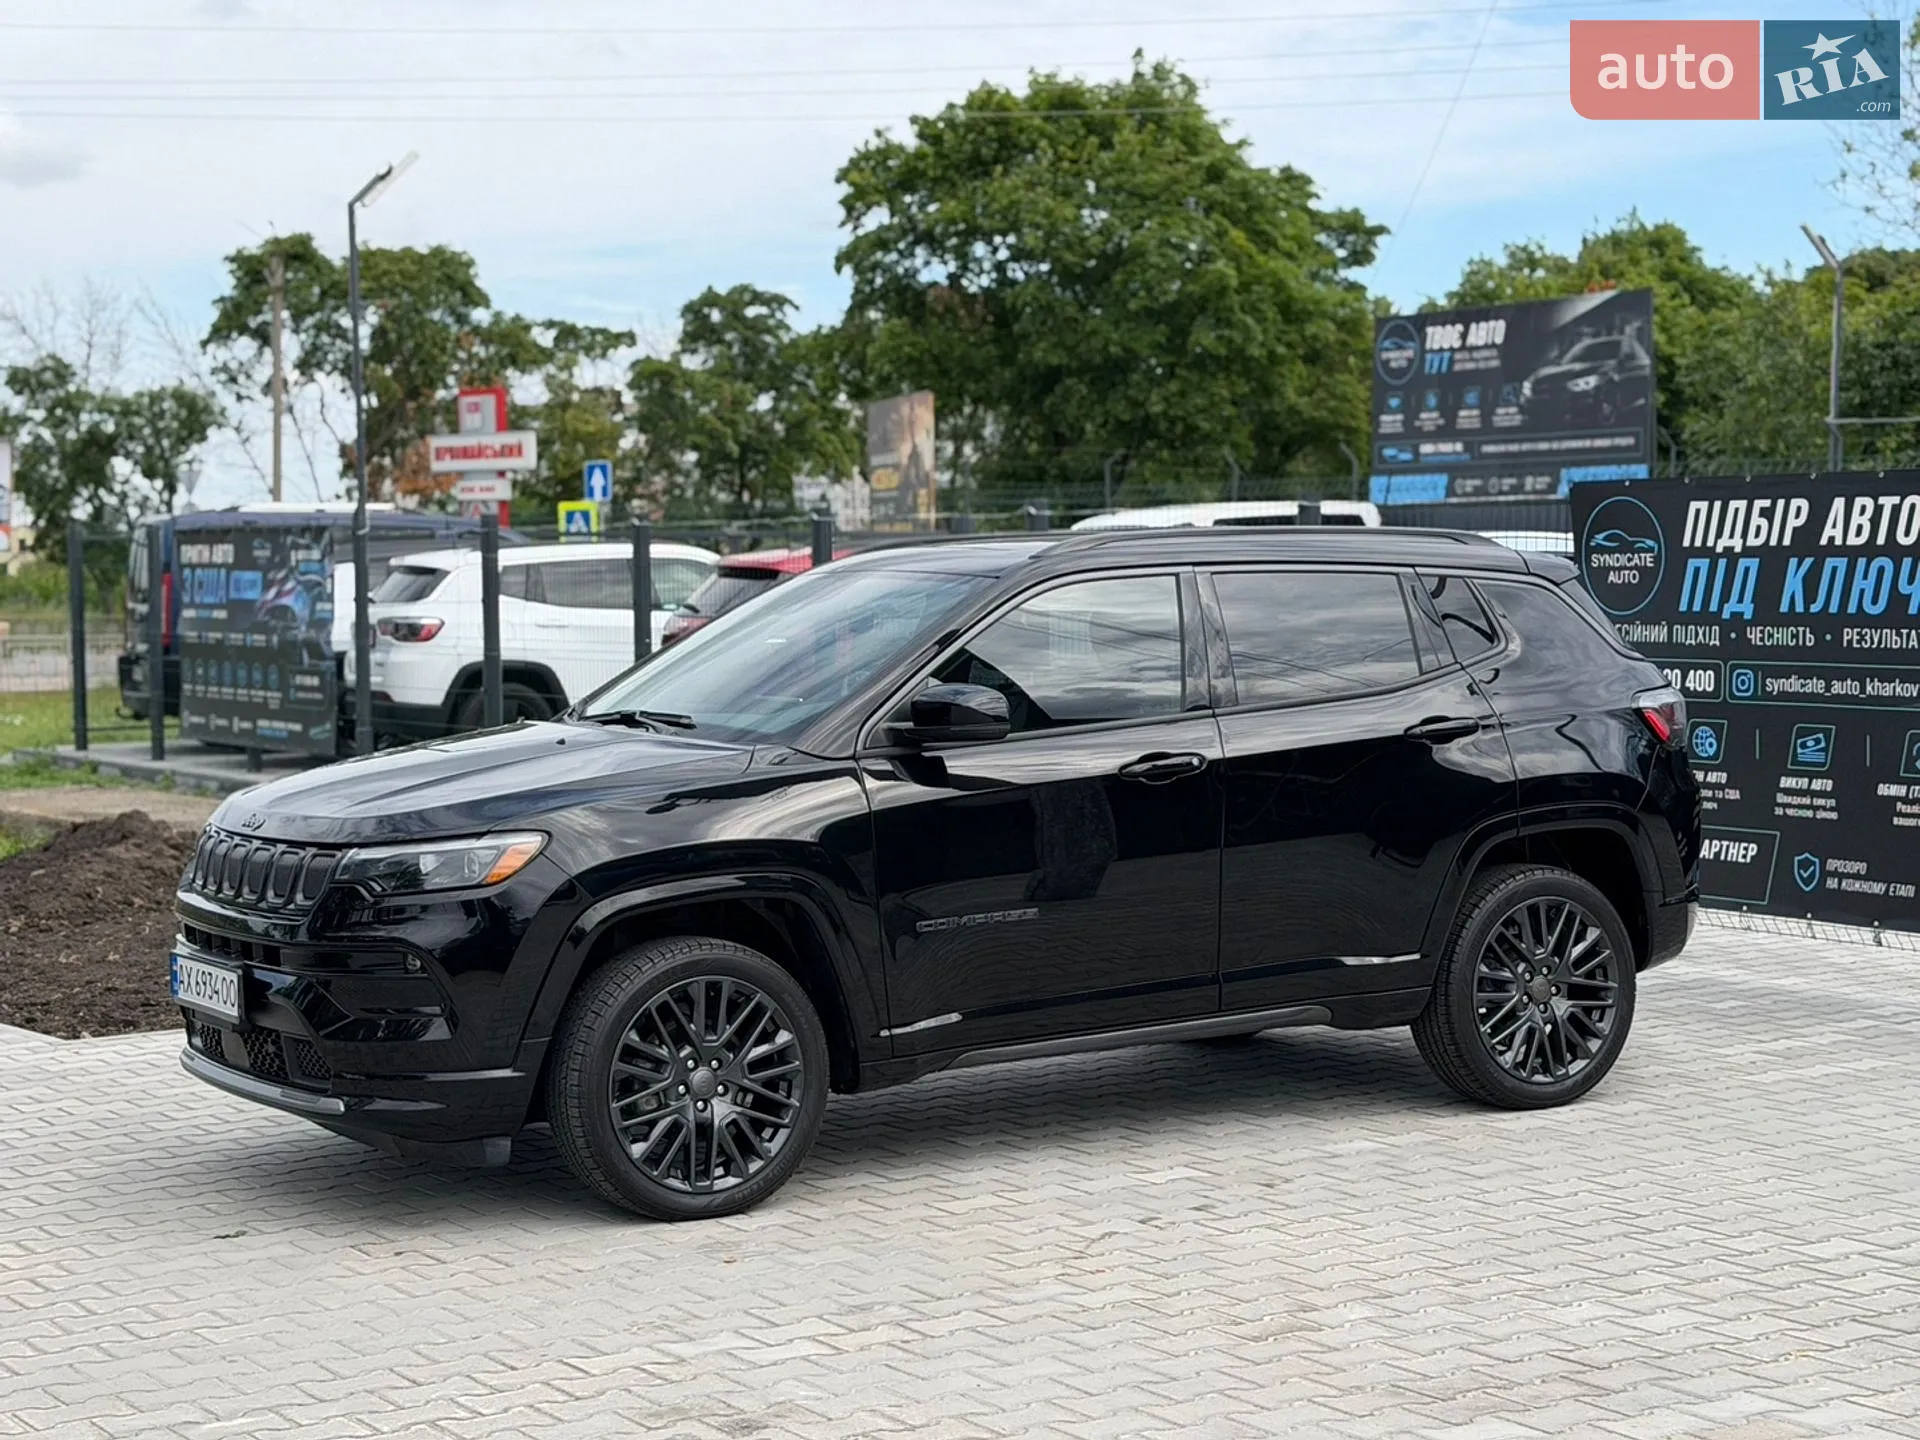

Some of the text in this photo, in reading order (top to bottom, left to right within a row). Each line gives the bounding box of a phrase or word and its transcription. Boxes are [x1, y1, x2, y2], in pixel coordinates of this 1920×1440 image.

[1465, 319, 1506, 347] АВТО
[1682, 495, 1920, 553] ПІДБІР АВТО
[1591, 553, 1655, 567] SYNDICATE
[1607, 570, 1639, 584] AUTO
[1678, 558, 1760, 619] ПІД
[1673, 624, 1720, 646] ПІДХІД
[1746, 626, 1815, 647] ЧЕСНІСТЬ
[1843, 628, 1920, 649] РЕЗУЛЬТА
[1685, 670, 1715, 692] 400
[1765, 675, 1919, 698] syndicate_auto_kharkov
[1826, 876, 1839, 889] НА
